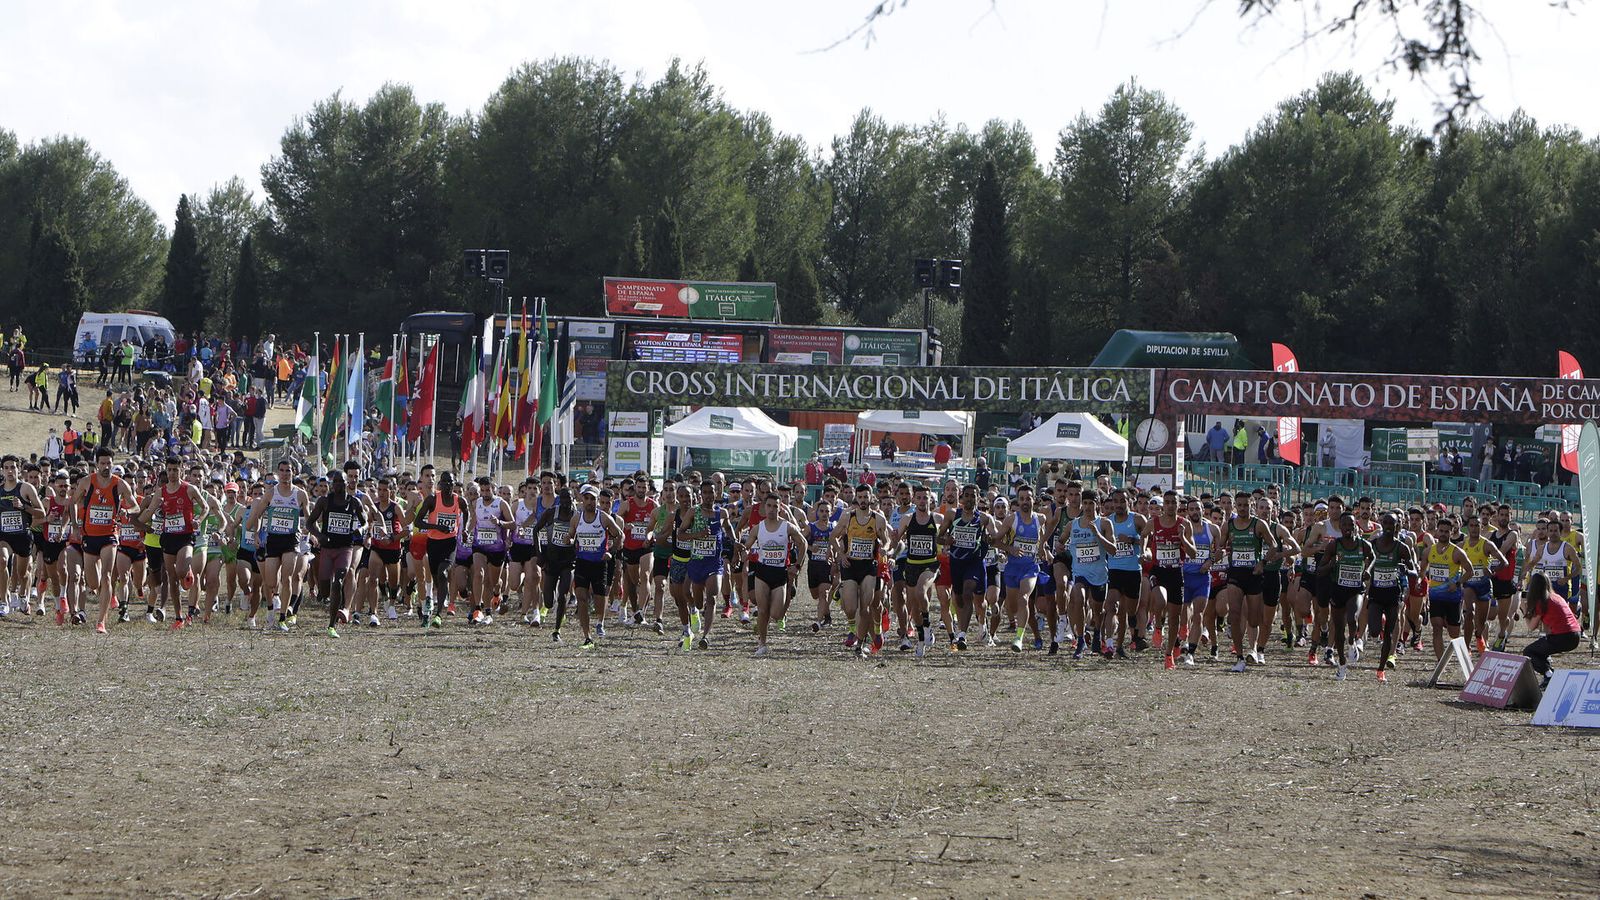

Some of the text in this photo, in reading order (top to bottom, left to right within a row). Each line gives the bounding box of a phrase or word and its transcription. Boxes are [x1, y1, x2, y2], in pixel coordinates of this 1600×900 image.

[705, 294, 741, 302] ITÁLICA
[860, 340, 890, 350] ITÁLICA
[1146, 345, 1188, 355] DIPUTACION
[1203, 348, 1230, 356] SEVILLA
[626, 370, 1132, 402] CROSS INTERNACIONAL DE ITÁLICA
[1542, 384, 1564, 400] DE
[1168, 378, 1537, 412] CAMPEONATO DE ESPAÑA
[1542, 403, 1600, 419] POR CL
[3, 515, 22, 525] ARESE
